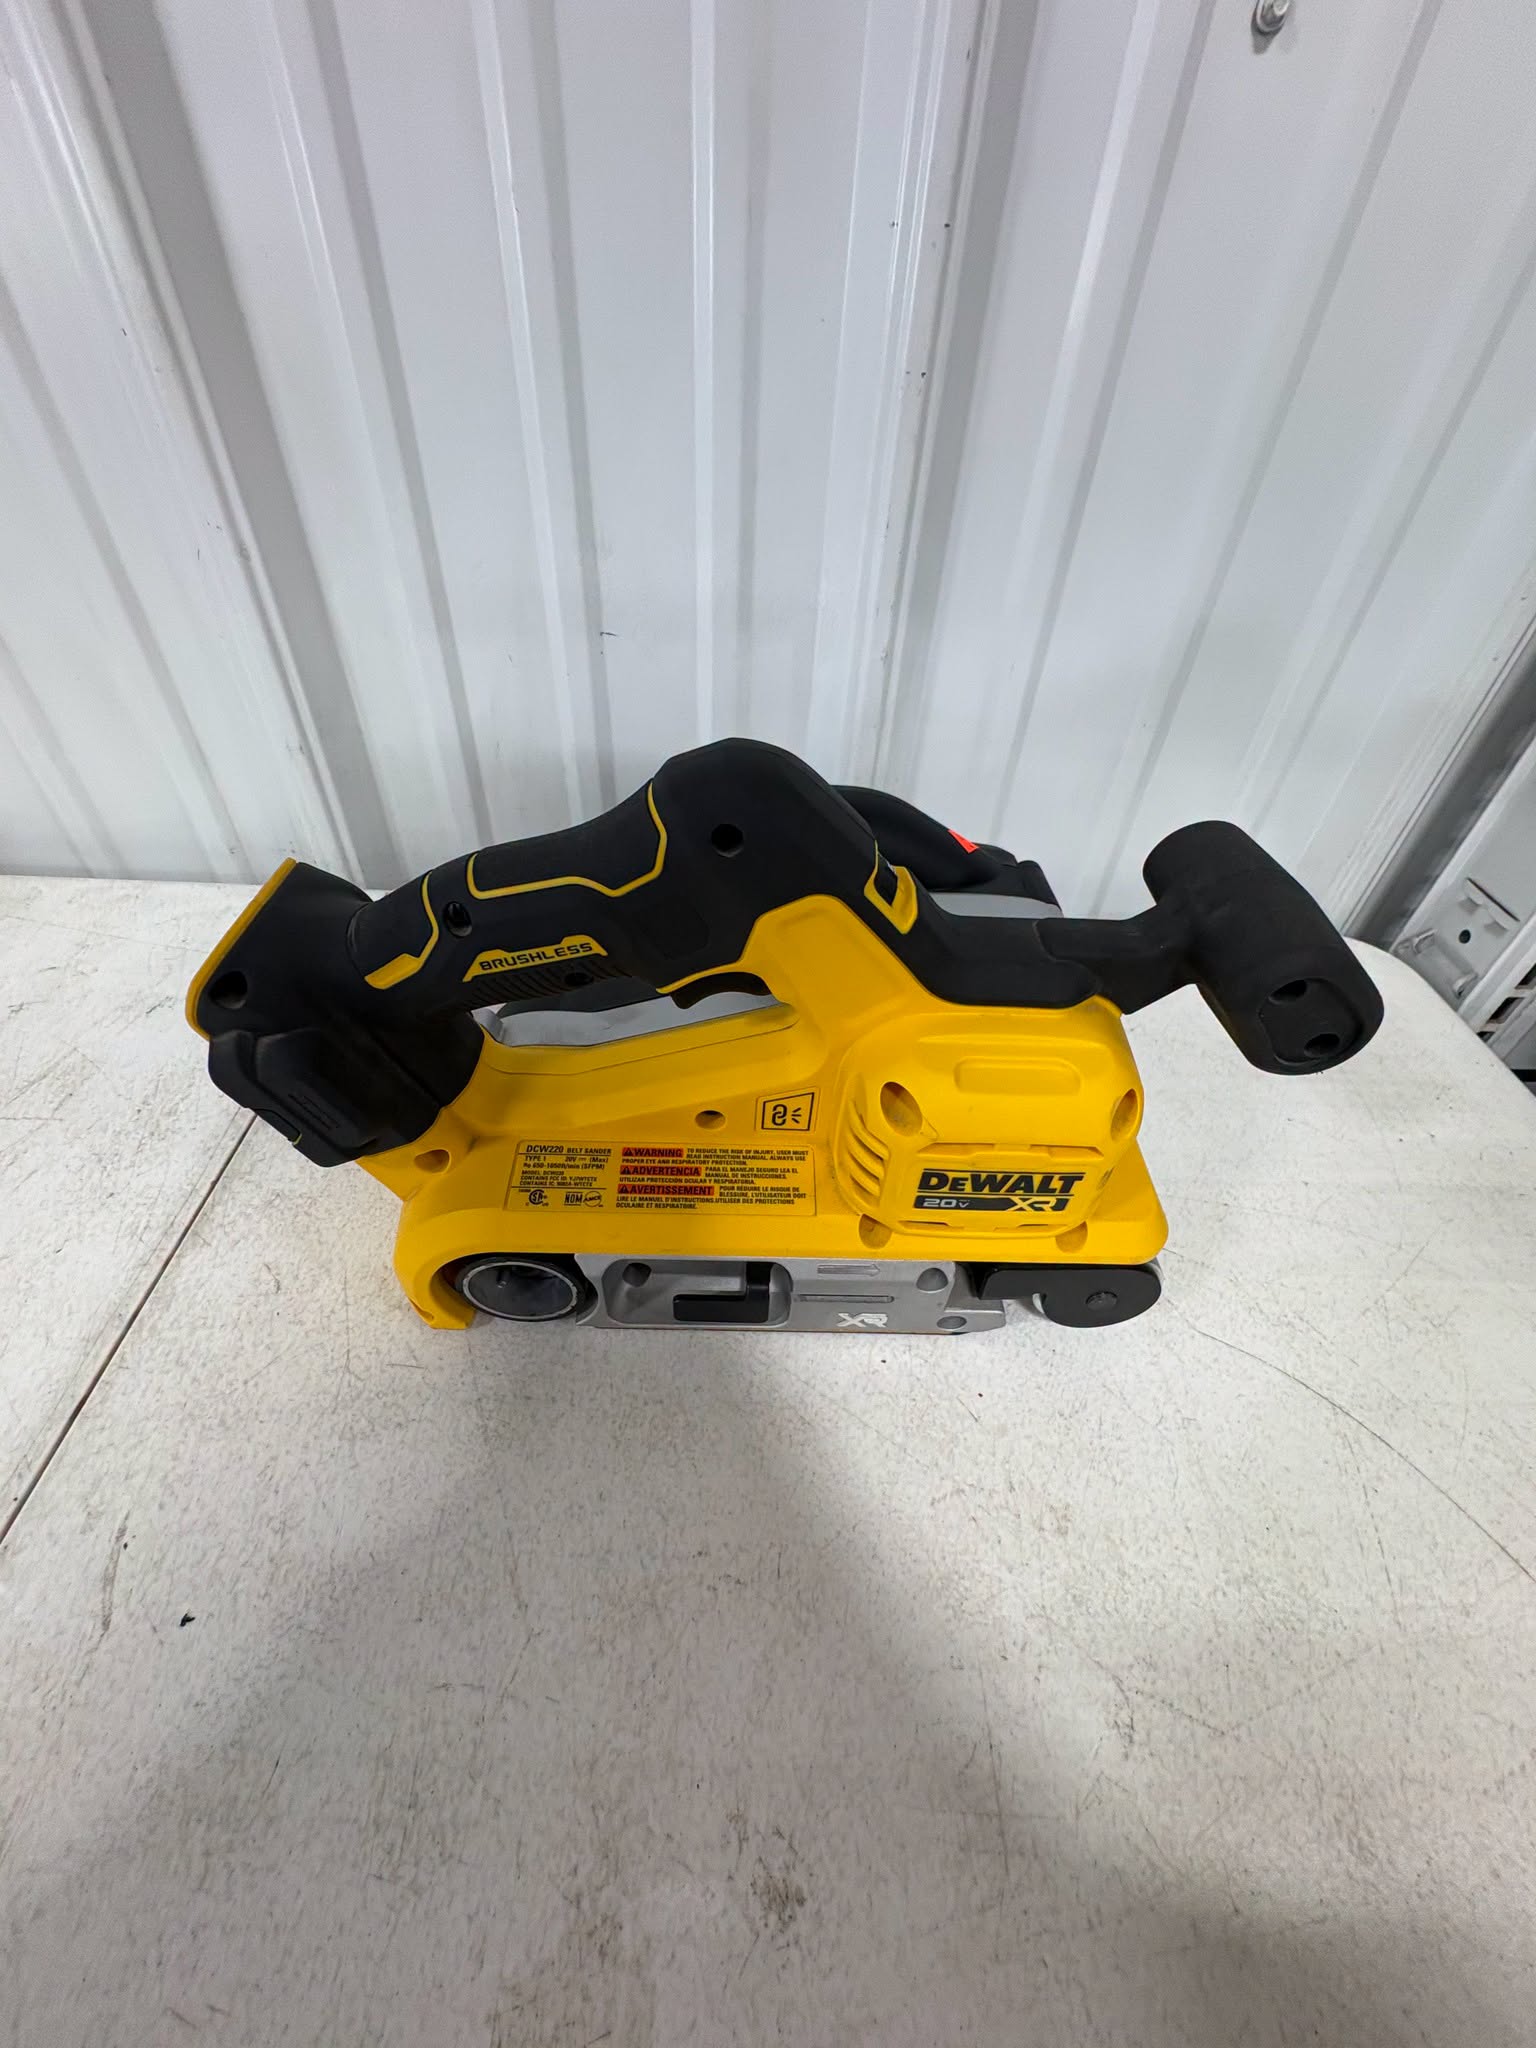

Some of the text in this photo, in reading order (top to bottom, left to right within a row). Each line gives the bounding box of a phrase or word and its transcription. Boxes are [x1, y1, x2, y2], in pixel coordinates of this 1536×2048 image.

[478, 942, 592, 970] BRUSHLESS
[526, 1144, 564, 1152] DCW220
[634, 1148, 683, 1157] WARNING
[632, 1166, 700, 1176] ADVERTENCIA
[630, 1185, 713, 1195] AVERTISSEMENT
[1006, 1196, 1058, 1212] XR
[836, 1313, 888, 1327] XR
